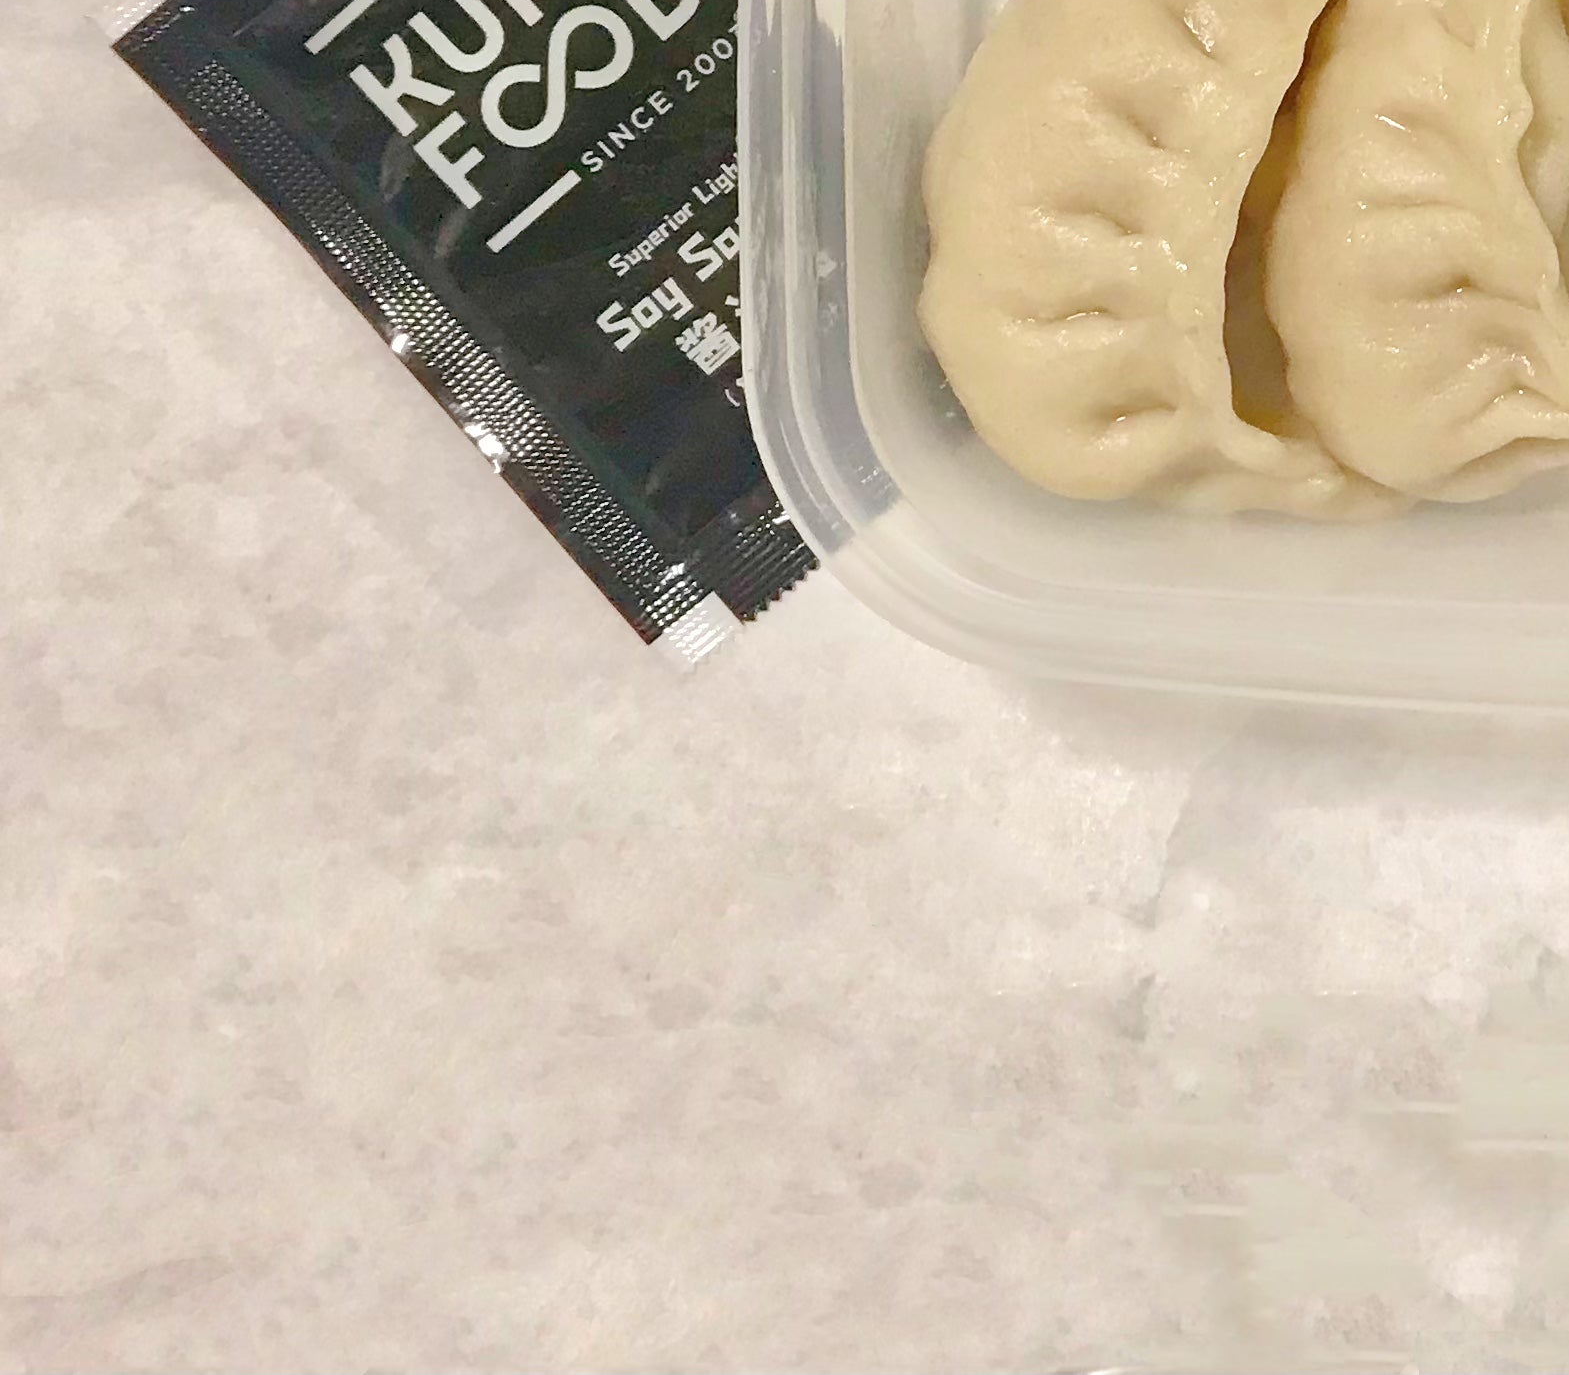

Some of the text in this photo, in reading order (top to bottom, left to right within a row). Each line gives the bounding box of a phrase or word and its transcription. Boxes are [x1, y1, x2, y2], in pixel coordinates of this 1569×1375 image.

[580, 90, 674, 173] SINCE
[608, 152, 738, 277] Superior Ligh
[596, 276, 694, 352] Soy
